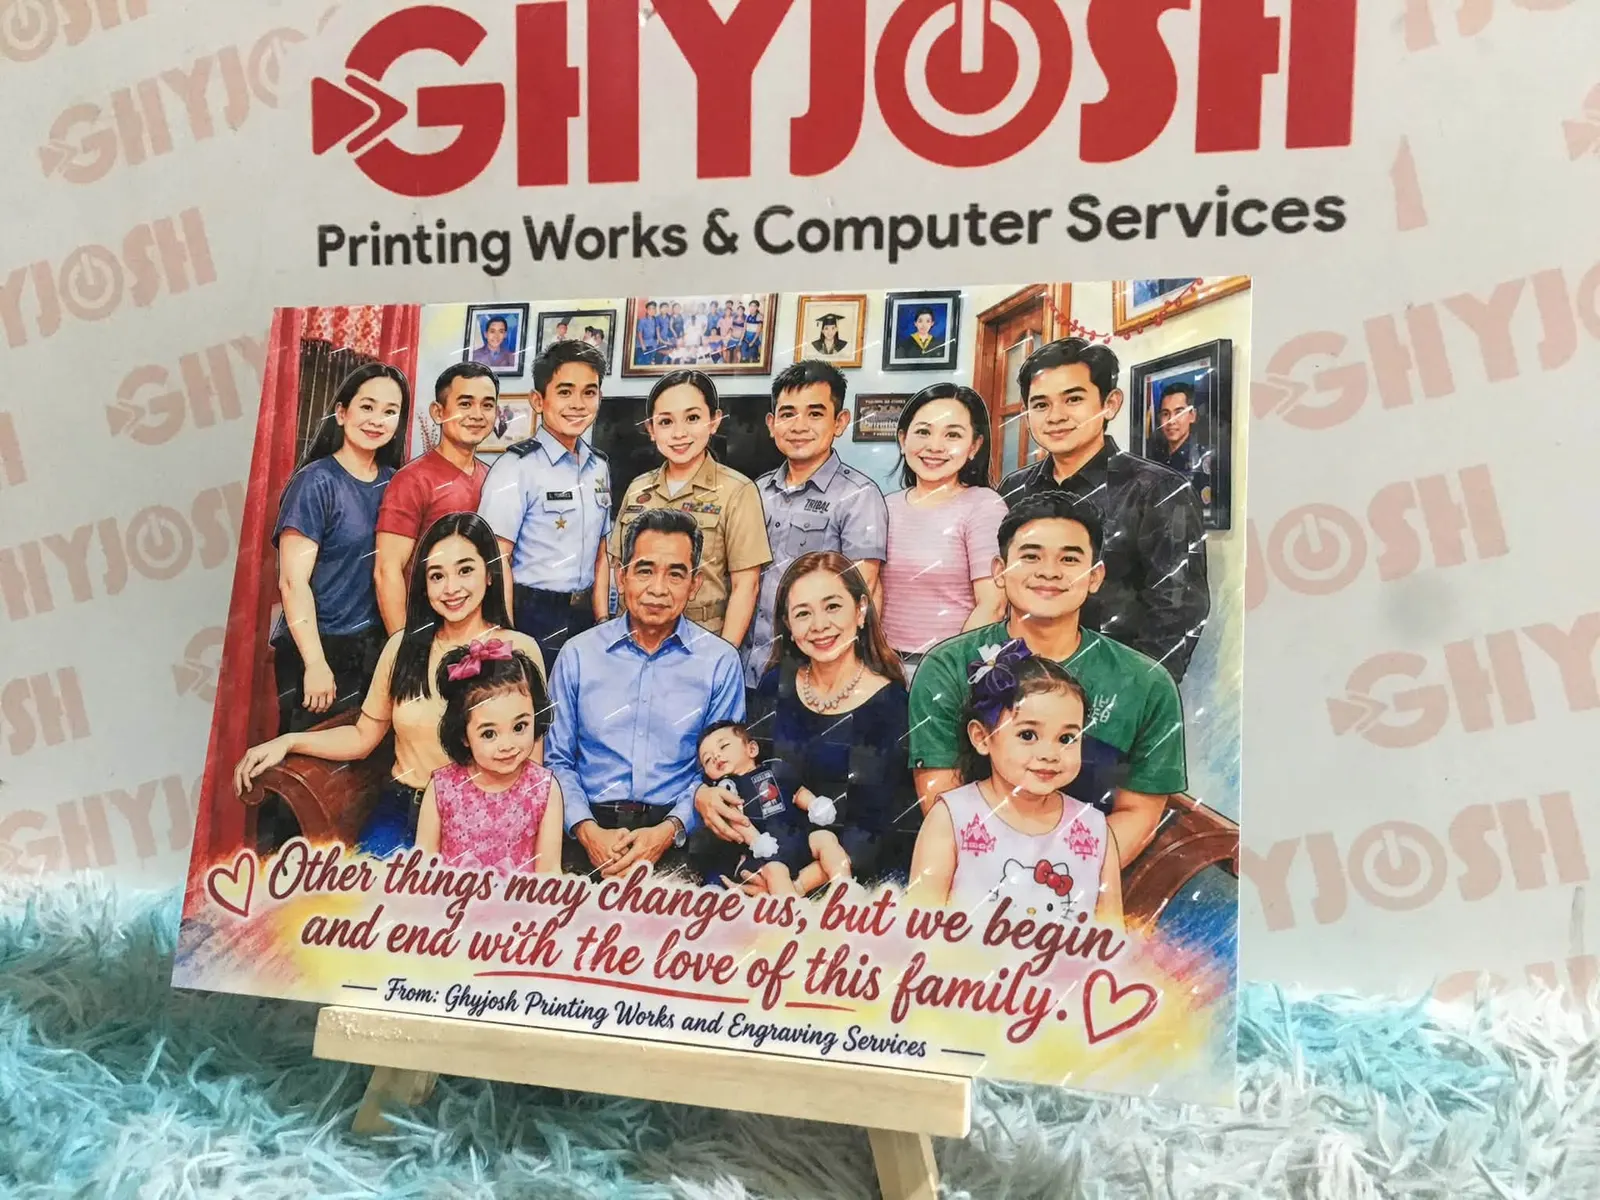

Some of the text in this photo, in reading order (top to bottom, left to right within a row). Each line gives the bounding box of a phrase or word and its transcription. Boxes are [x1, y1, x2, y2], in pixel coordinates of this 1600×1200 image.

[311, 0, 1357, 197] GHYJOSH
[318, 184, 1348, 277] Printing Works & Computer Services
[1250, 262, 1600, 430] GHYJ
[268, 840, 1125, 973] Other things may change us, but we begin
[301, 904, 1068, 1043] and end with the love of this family.
[384, 977, 928, 1058] From: Ghyjosh Printing Works and Engraving Services
